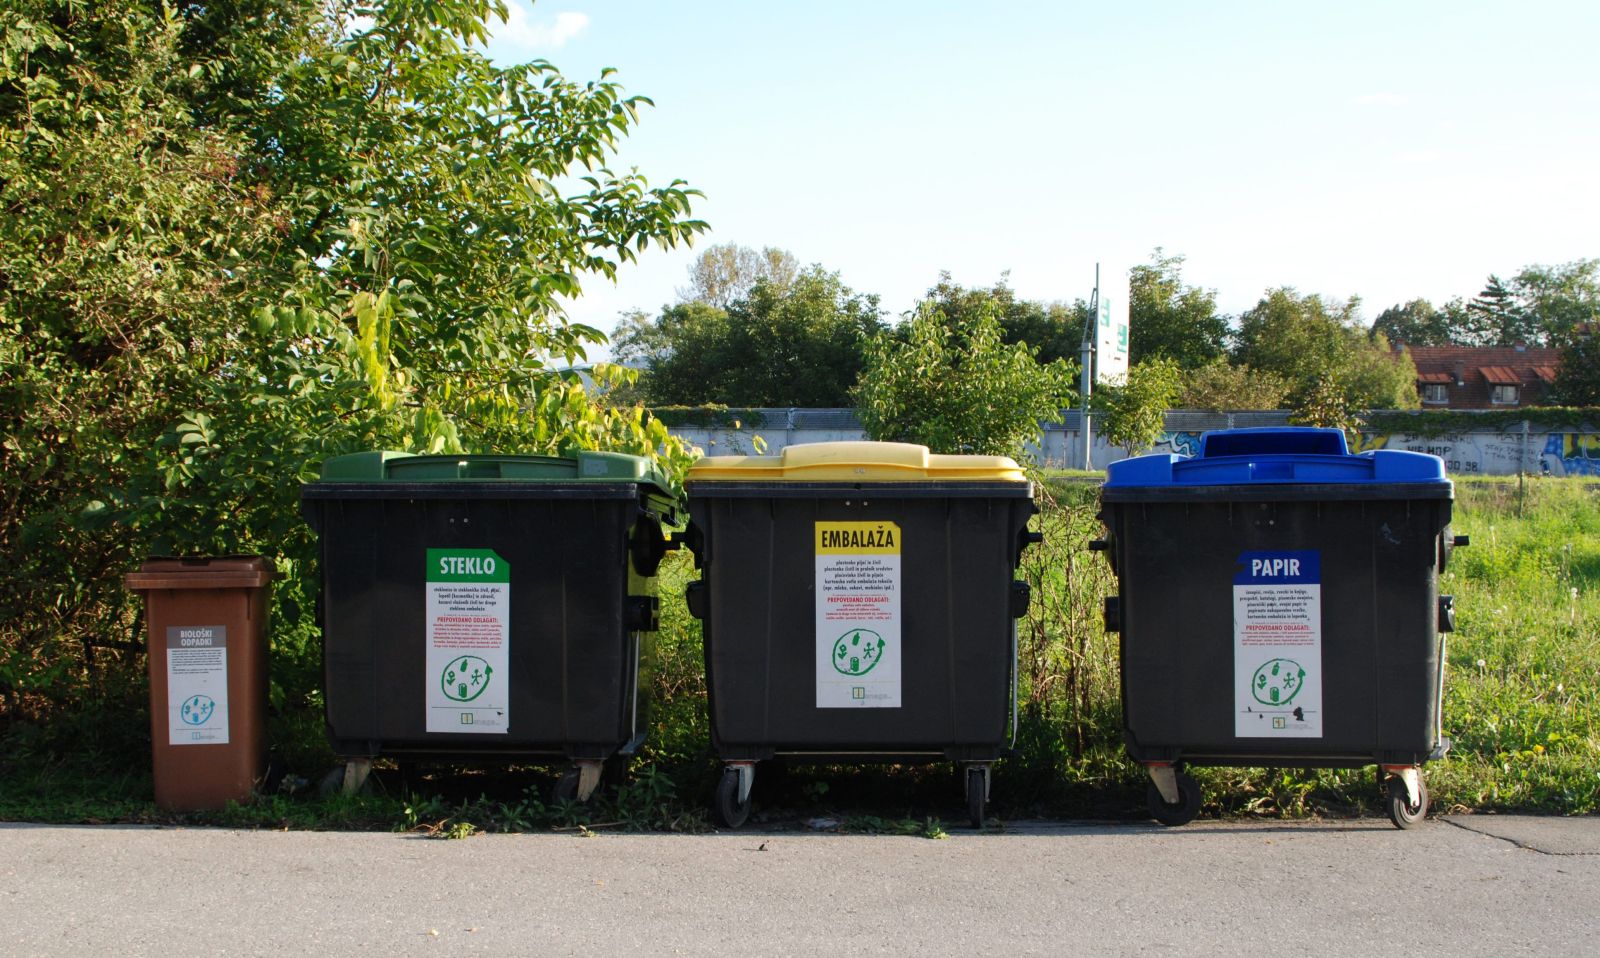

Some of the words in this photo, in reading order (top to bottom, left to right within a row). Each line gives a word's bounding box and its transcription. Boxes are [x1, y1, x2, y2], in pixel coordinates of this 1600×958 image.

[822, 525, 894, 548] EMBALAŽA
[440, 557, 496, 575] STEKLO
[1252, 559, 1301, 577] PAPIR
[180, 628, 213, 638] BIOLOŠKI
[181, 638, 213, 647] ODPADKI
